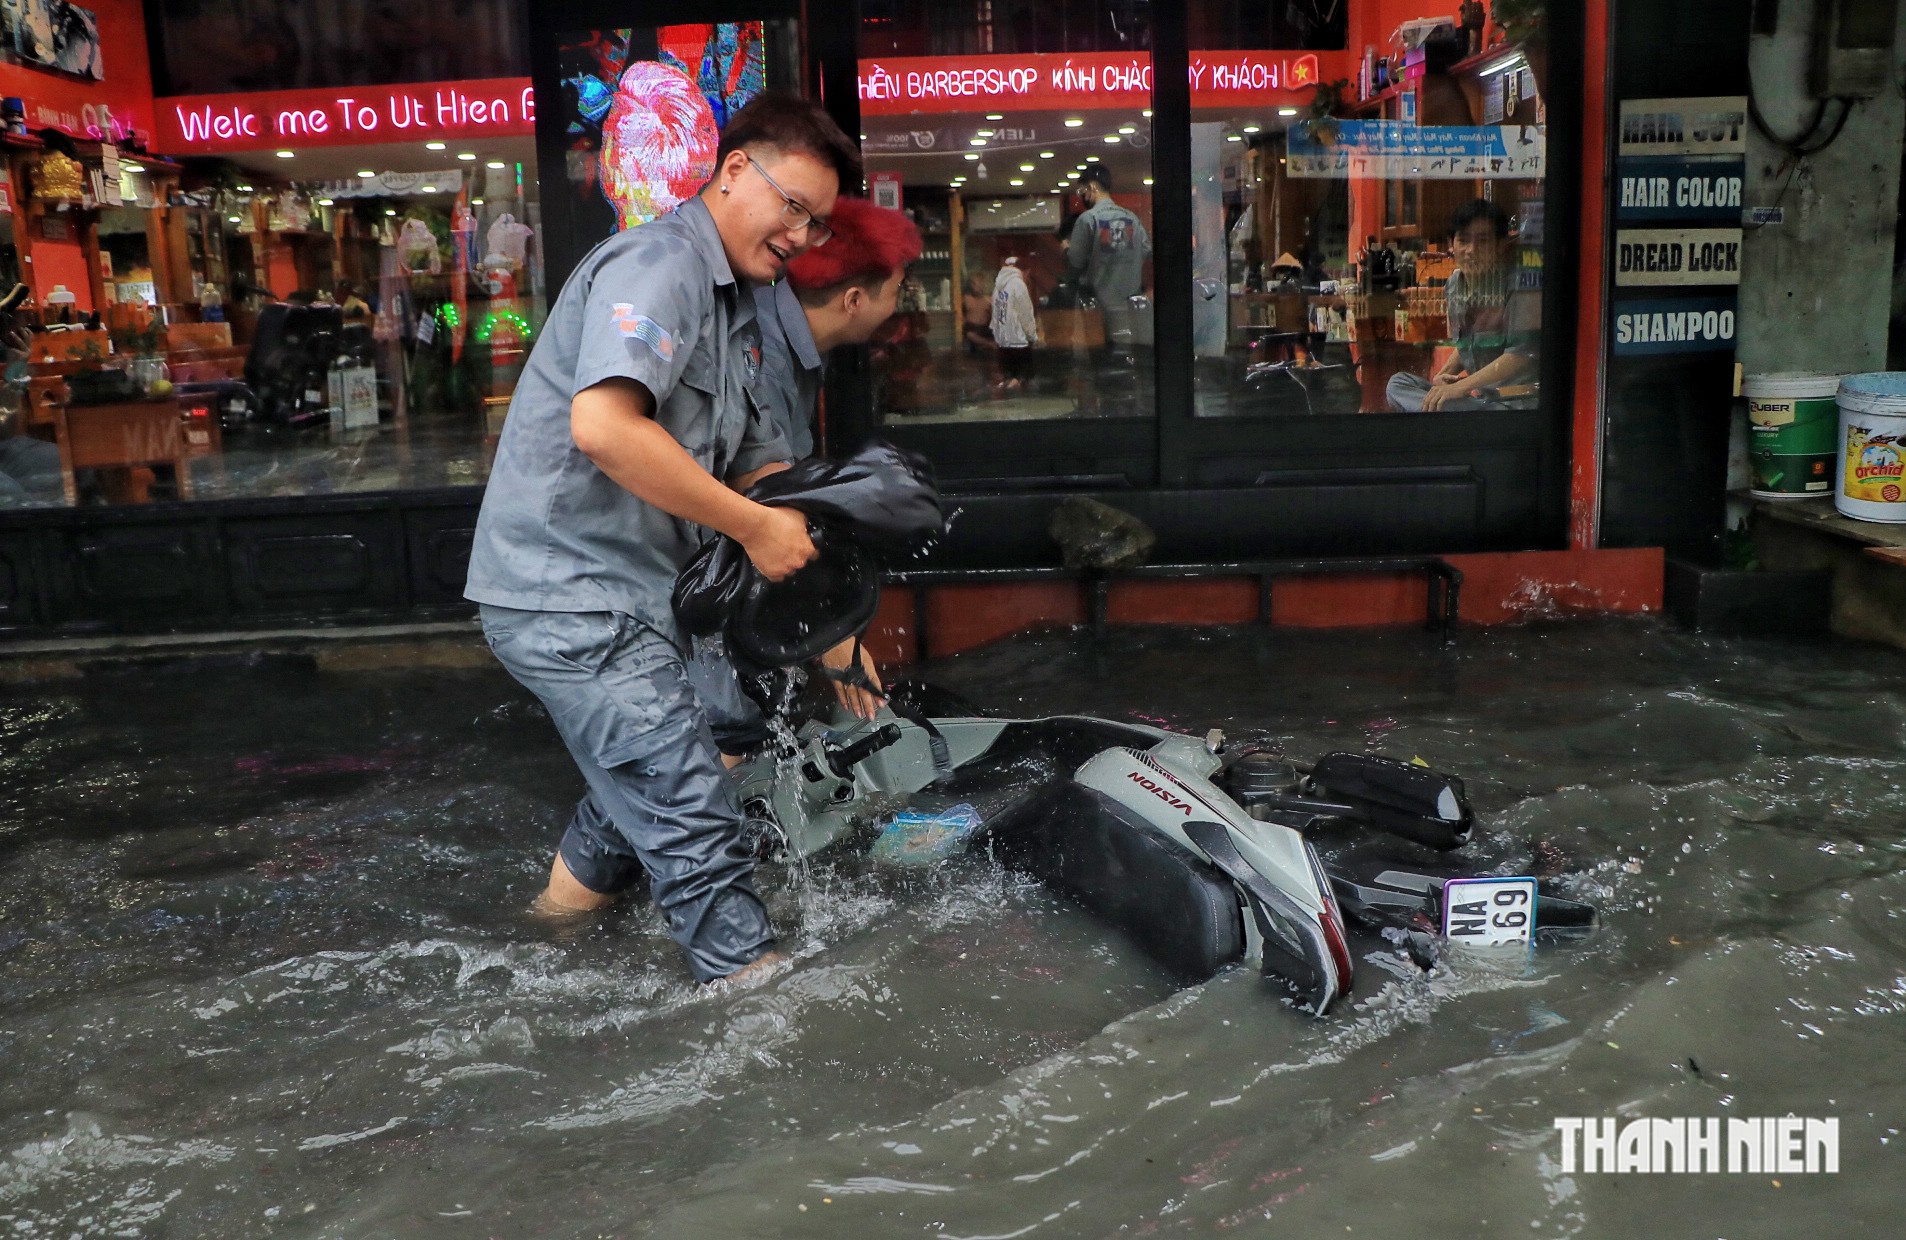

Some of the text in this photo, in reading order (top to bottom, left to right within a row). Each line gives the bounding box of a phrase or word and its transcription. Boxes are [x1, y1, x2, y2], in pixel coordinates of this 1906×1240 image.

[907, 68, 1037, 97] BARBERSHOP
[1052, 60, 1095, 92] KÍNH
[1212, 57, 1278, 89] KHÁCH
[336, 98, 377, 131] To
[390, 95, 427, 128] Ut
[436, 89, 508, 126] Hien
[1621, 177, 1741, 207] HAIR COLOR
[1620, 242, 1738, 272] DREAD LOCK
[1616, 310, 1734, 344] SHAMPOO
[1855, 461, 1905, 479] orchid
[1127, 772, 1192, 816] VISION
